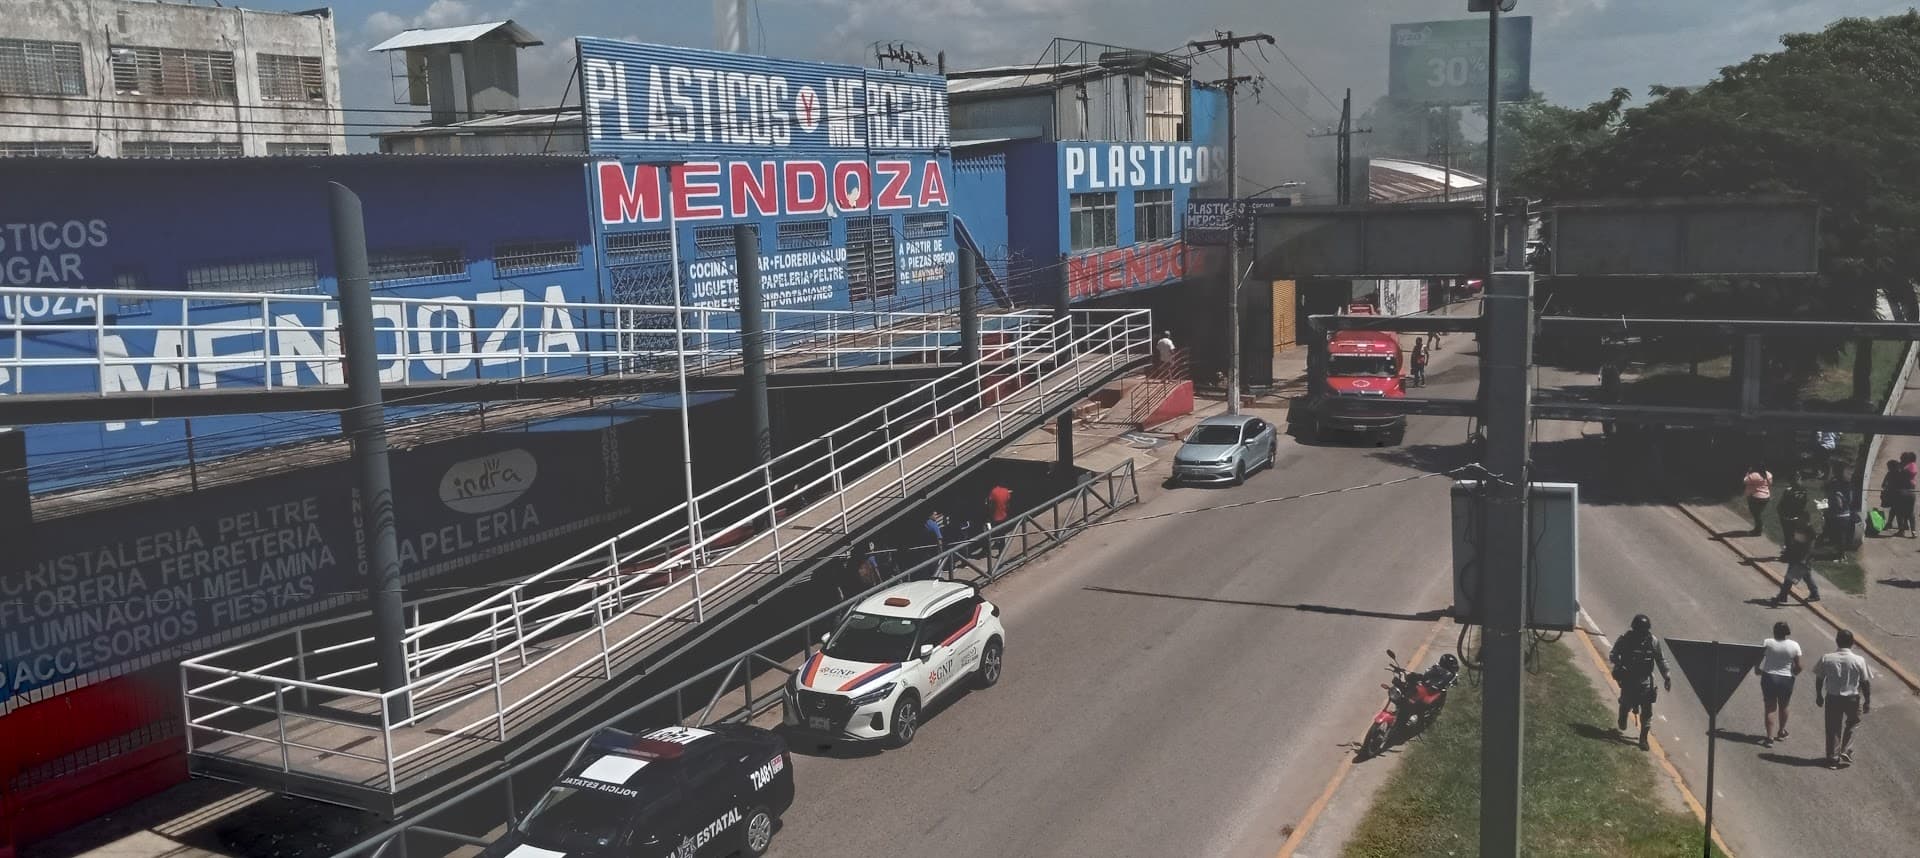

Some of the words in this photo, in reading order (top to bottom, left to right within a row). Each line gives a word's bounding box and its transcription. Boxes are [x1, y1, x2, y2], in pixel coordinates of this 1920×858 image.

[585, 58, 790, 147] PLASTICOS
[801, 90, 814, 127] Y
[597, 160, 949, 224] MENDOZA
[0, 219, 108, 252] TICOS
[906, 241, 931, 254] PARTIR
[933, 239, 943, 252] DE
[690, 258, 728, 280] COCINA
[774, 255, 818, 269] FLORERIA
[692, 278, 739, 298] JUGUETE
[761, 271, 810, 289] PAPELERIA
[813, 267, 844, 282] PELTRE
[900, 271, 910, 285] DE
[908, 255, 932, 270] PIEZAS
[103, 285, 581, 431] MENDOZA
[218, 497, 319, 541] PELTRE
[399, 502, 541, 568] APELERIA
[0, 568, 148, 627] FLORERIA
[160, 523, 324, 586] FERRETERIA
[4, 578, 194, 661] ILUMINACION
[203, 545, 337, 600] MELAMINA
[13, 610, 199, 690] ACCESORIOS
[211, 576, 315, 627] FIESTAS
[830, 668, 856, 681] GNP
[750, 762, 773, 791] 72481
[697, 807, 742, 848] ESTATAL
